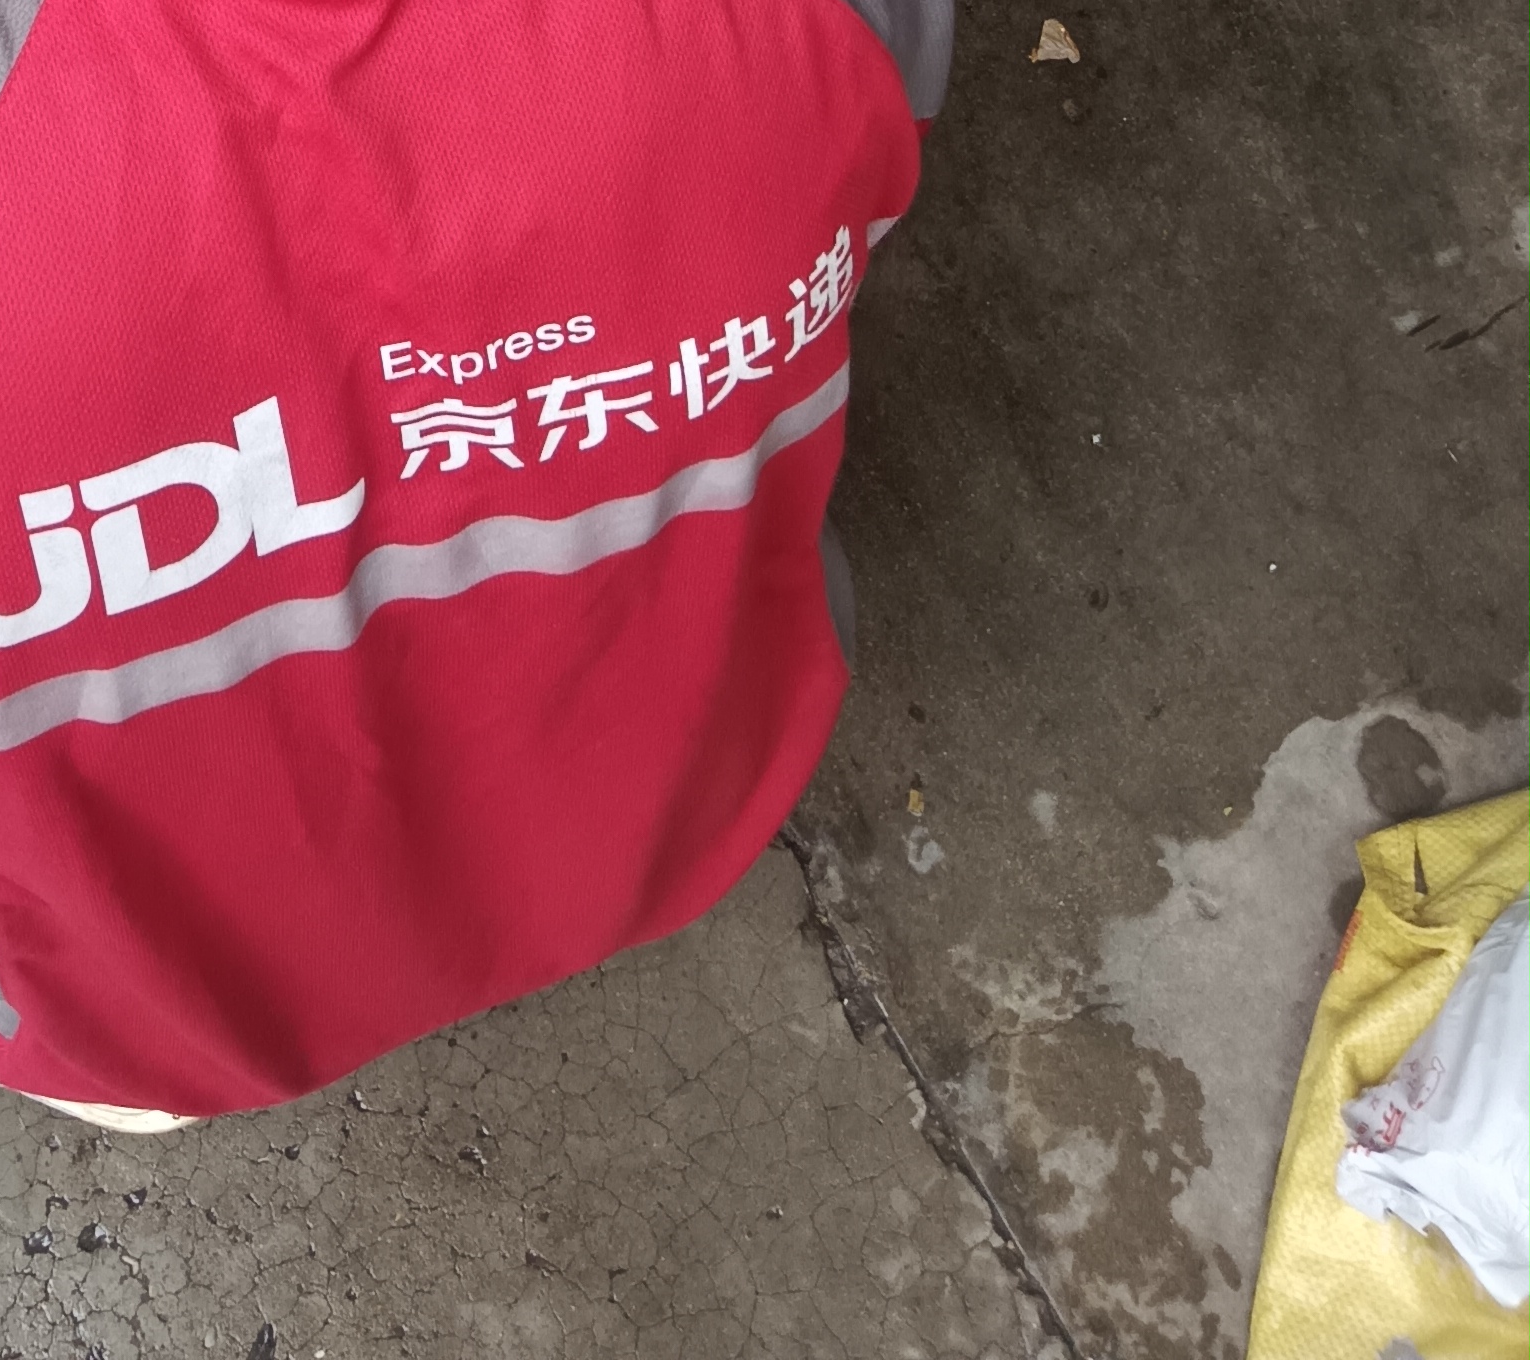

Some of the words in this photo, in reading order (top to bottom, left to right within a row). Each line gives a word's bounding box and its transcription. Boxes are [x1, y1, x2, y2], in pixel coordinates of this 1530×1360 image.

[379, 314, 597, 386] Express
[389, 224, 856, 481] 京东快递
